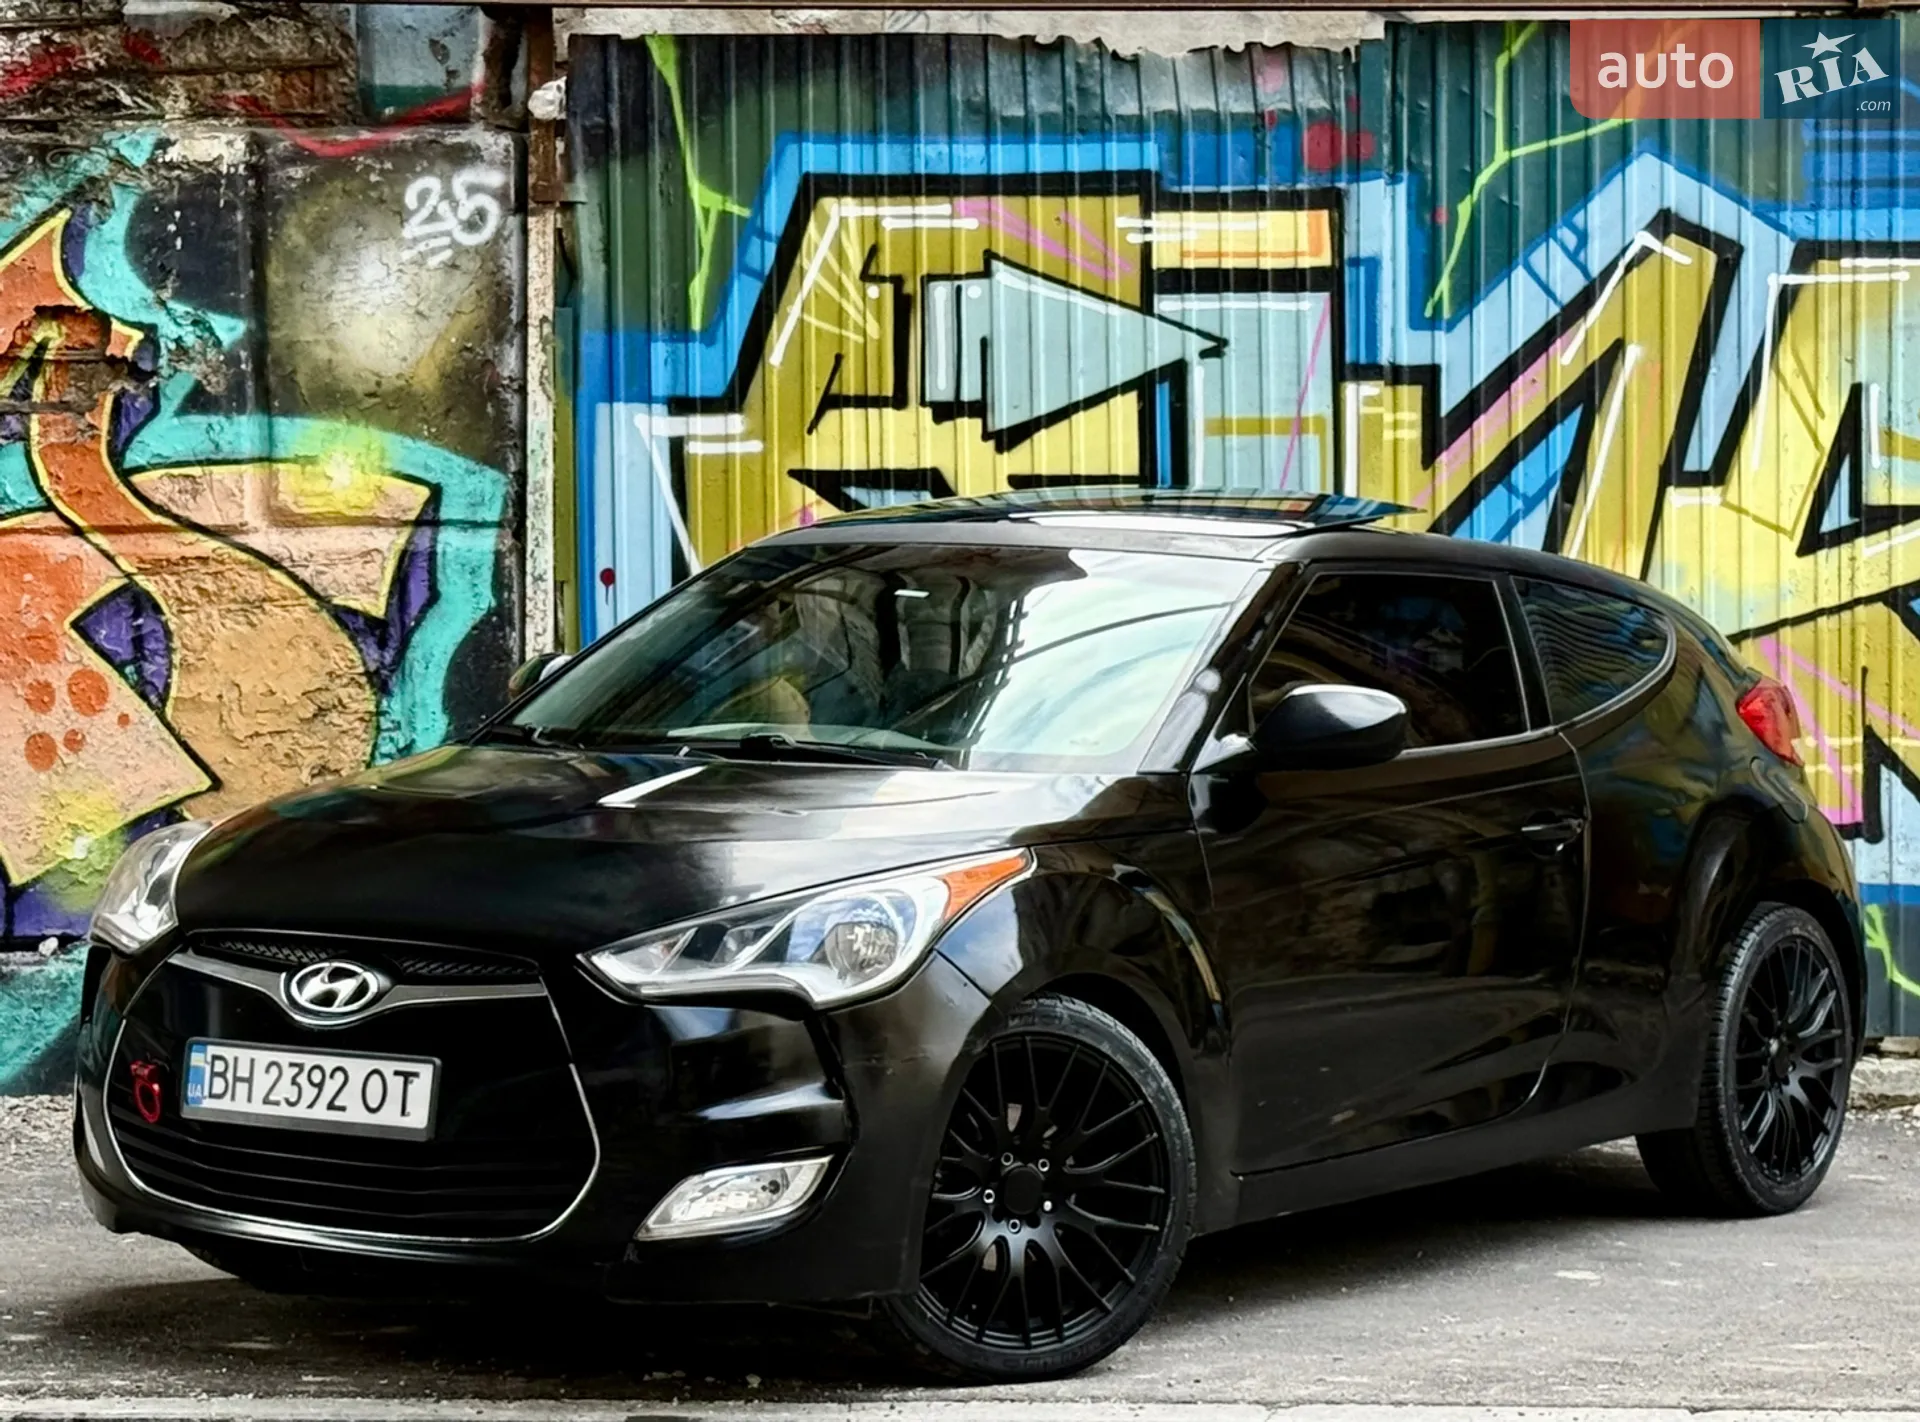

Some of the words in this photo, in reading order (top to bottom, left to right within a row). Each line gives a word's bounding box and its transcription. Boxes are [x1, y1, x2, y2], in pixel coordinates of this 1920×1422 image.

[402, 166, 506, 246] 25
[187, 1083, 203, 1097] UA
[208, 1054, 255, 1103] BH
[262, 1060, 350, 1112] 2392
[361, 1068, 420, 1117] OT
